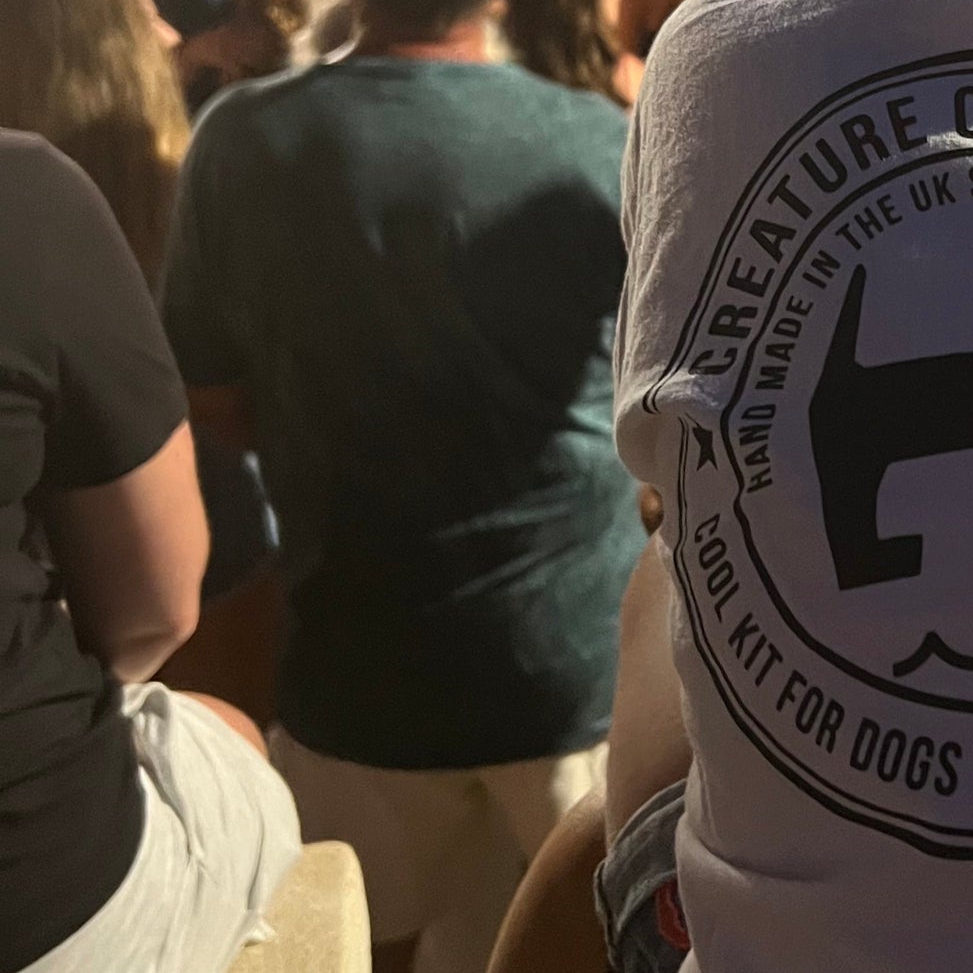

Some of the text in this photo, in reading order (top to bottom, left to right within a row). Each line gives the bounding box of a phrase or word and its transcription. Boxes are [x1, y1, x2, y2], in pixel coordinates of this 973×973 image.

[688, 96, 927, 375] CREATURE
[835, 194, 903, 250] THE
[909, 172, 956, 212] UK
[803, 250, 841, 289] IN
[755, 295, 814, 389] MADE
[738, 404, 776, 493] HAND
[694, 513, 739, 622] COOL
[728, 613, 783, 687] KIT
[776, 670, 845, 754] FOR
[850, 717, 962, 796] DOGS
